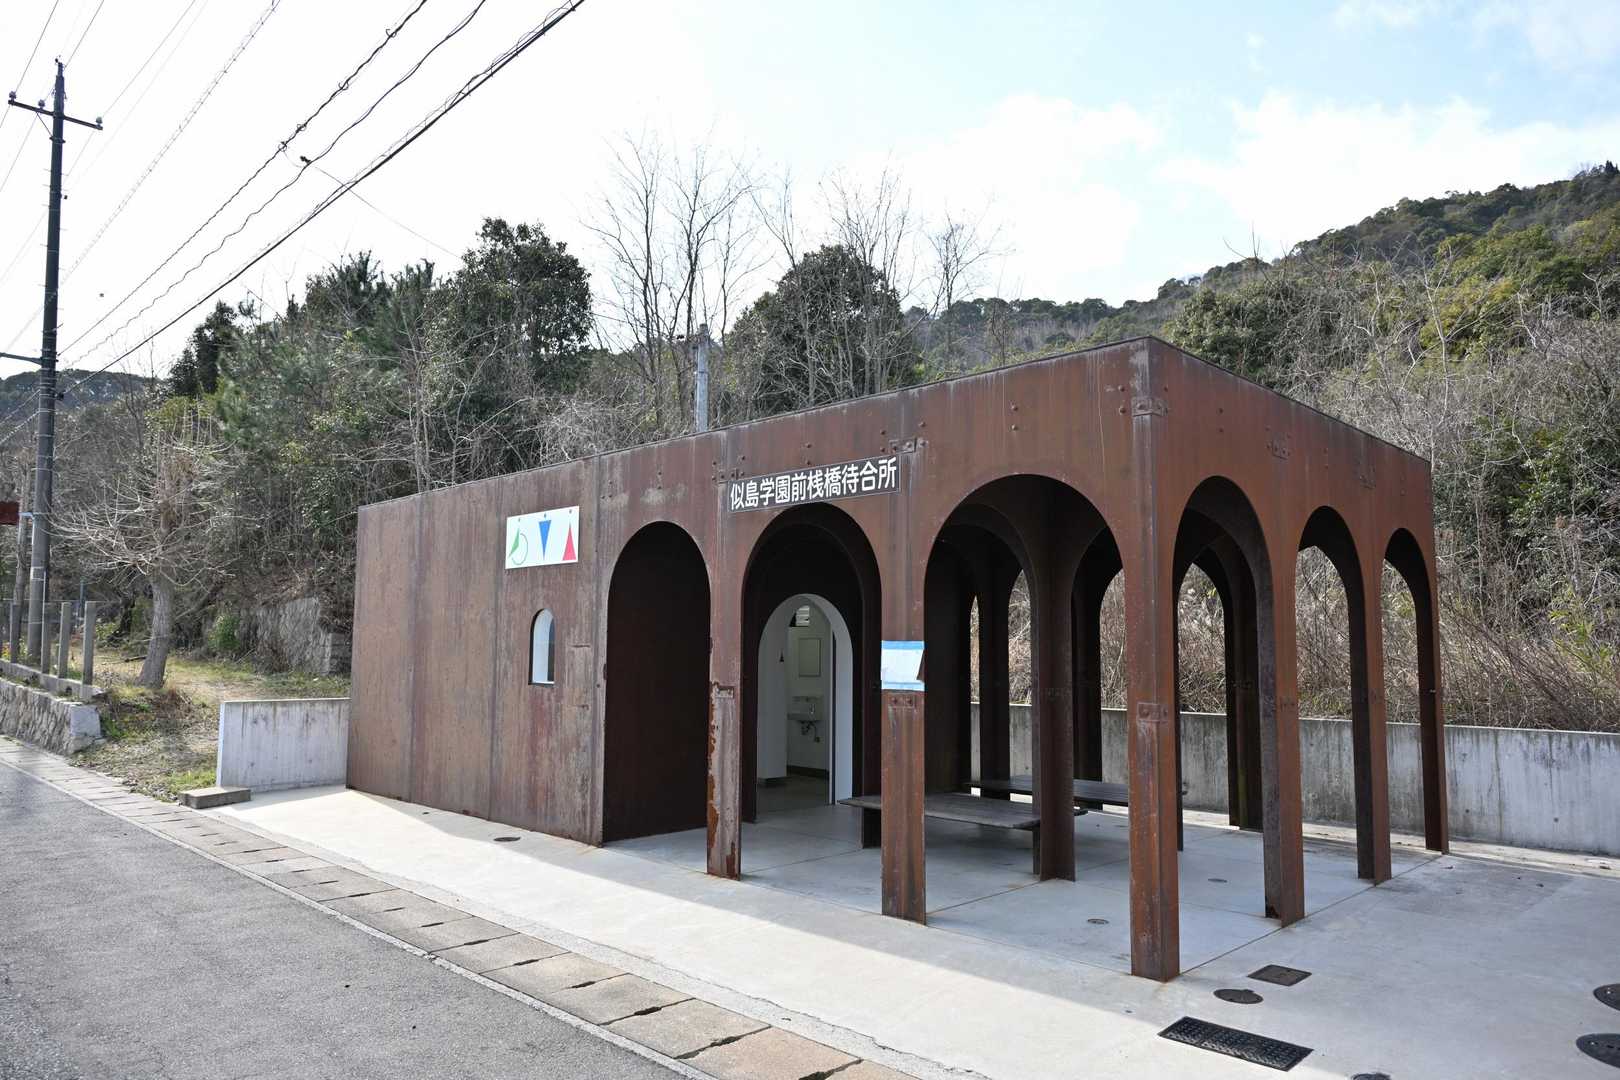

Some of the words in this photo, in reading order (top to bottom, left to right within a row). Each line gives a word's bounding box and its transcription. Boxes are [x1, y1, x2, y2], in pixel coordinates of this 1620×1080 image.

[730, 456, 897, 510] 似島学園前桟橋待合所
